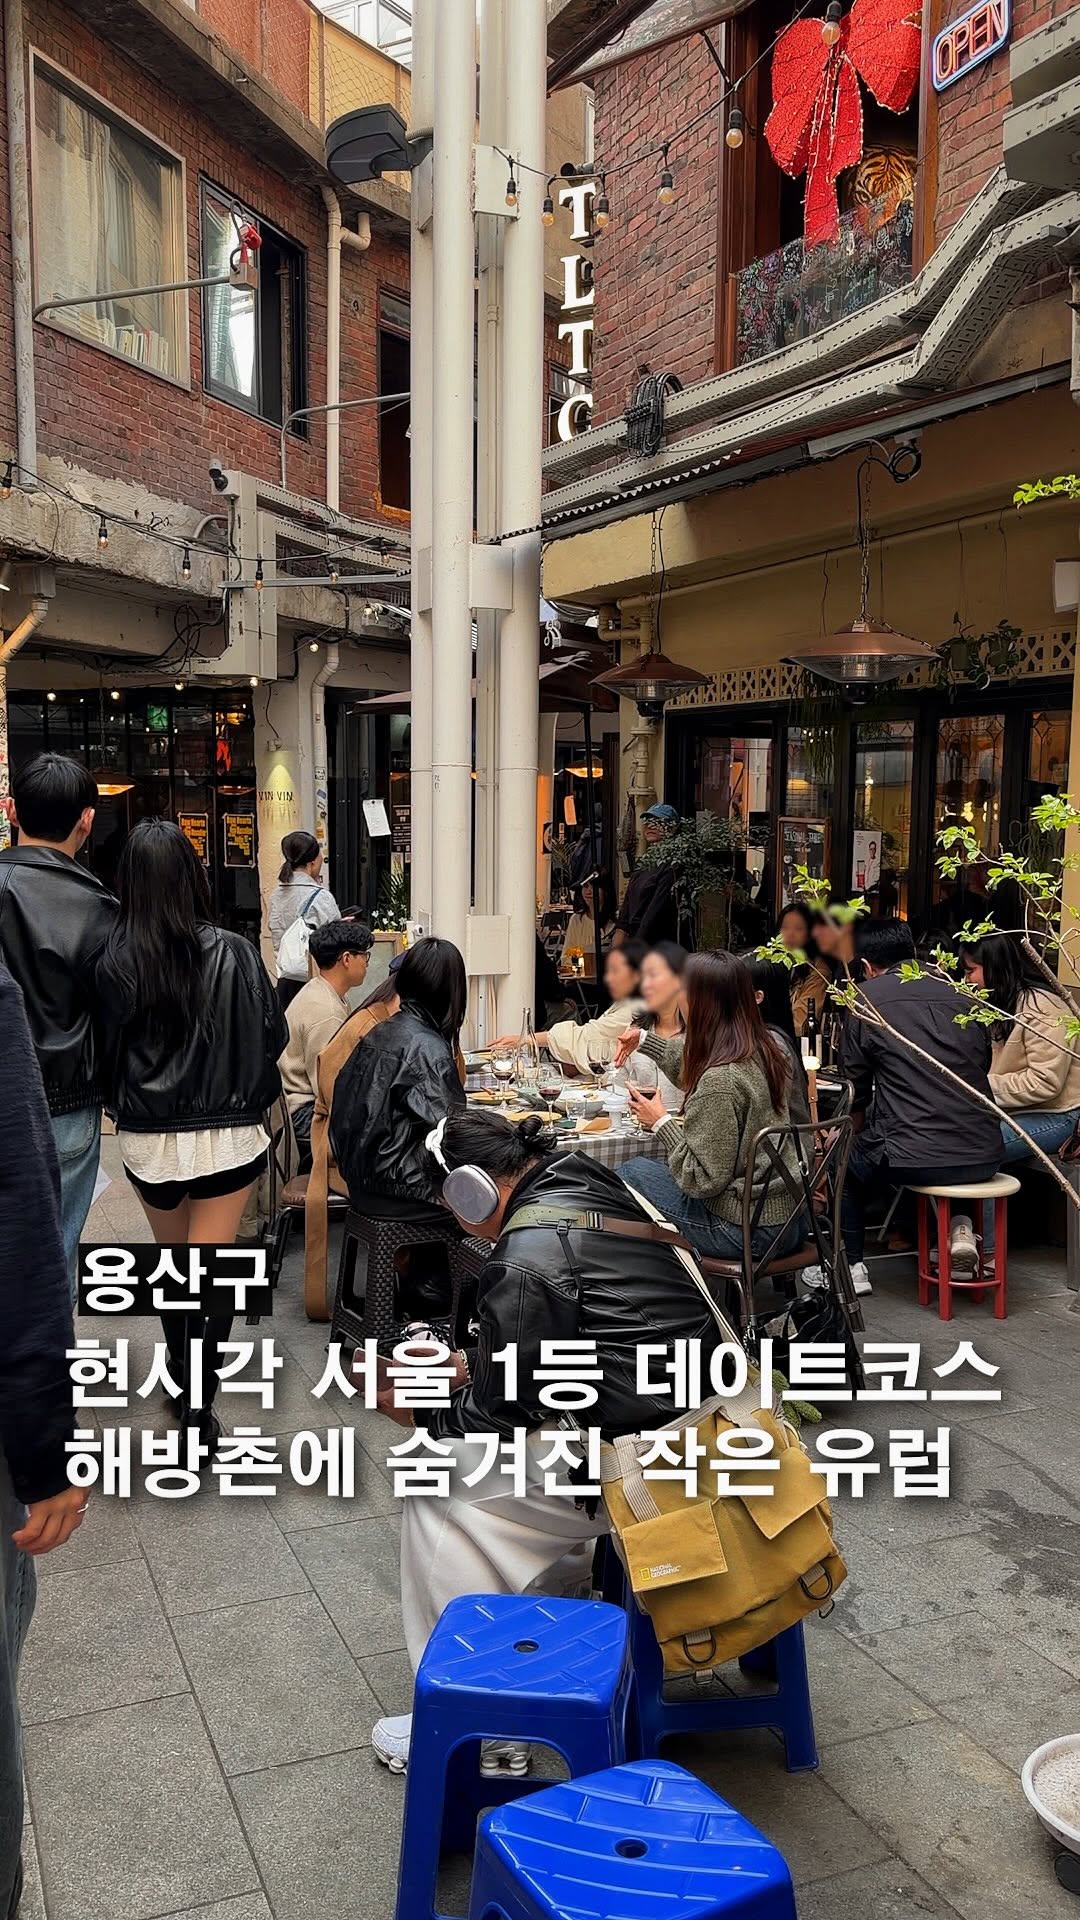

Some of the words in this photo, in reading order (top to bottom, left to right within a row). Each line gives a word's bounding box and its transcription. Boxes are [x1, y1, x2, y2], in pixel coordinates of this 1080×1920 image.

[936, 0, 1005, 81] OPEN
[258, 791, 274, 801] VIN
[277, 791, 293, 802] VIN
